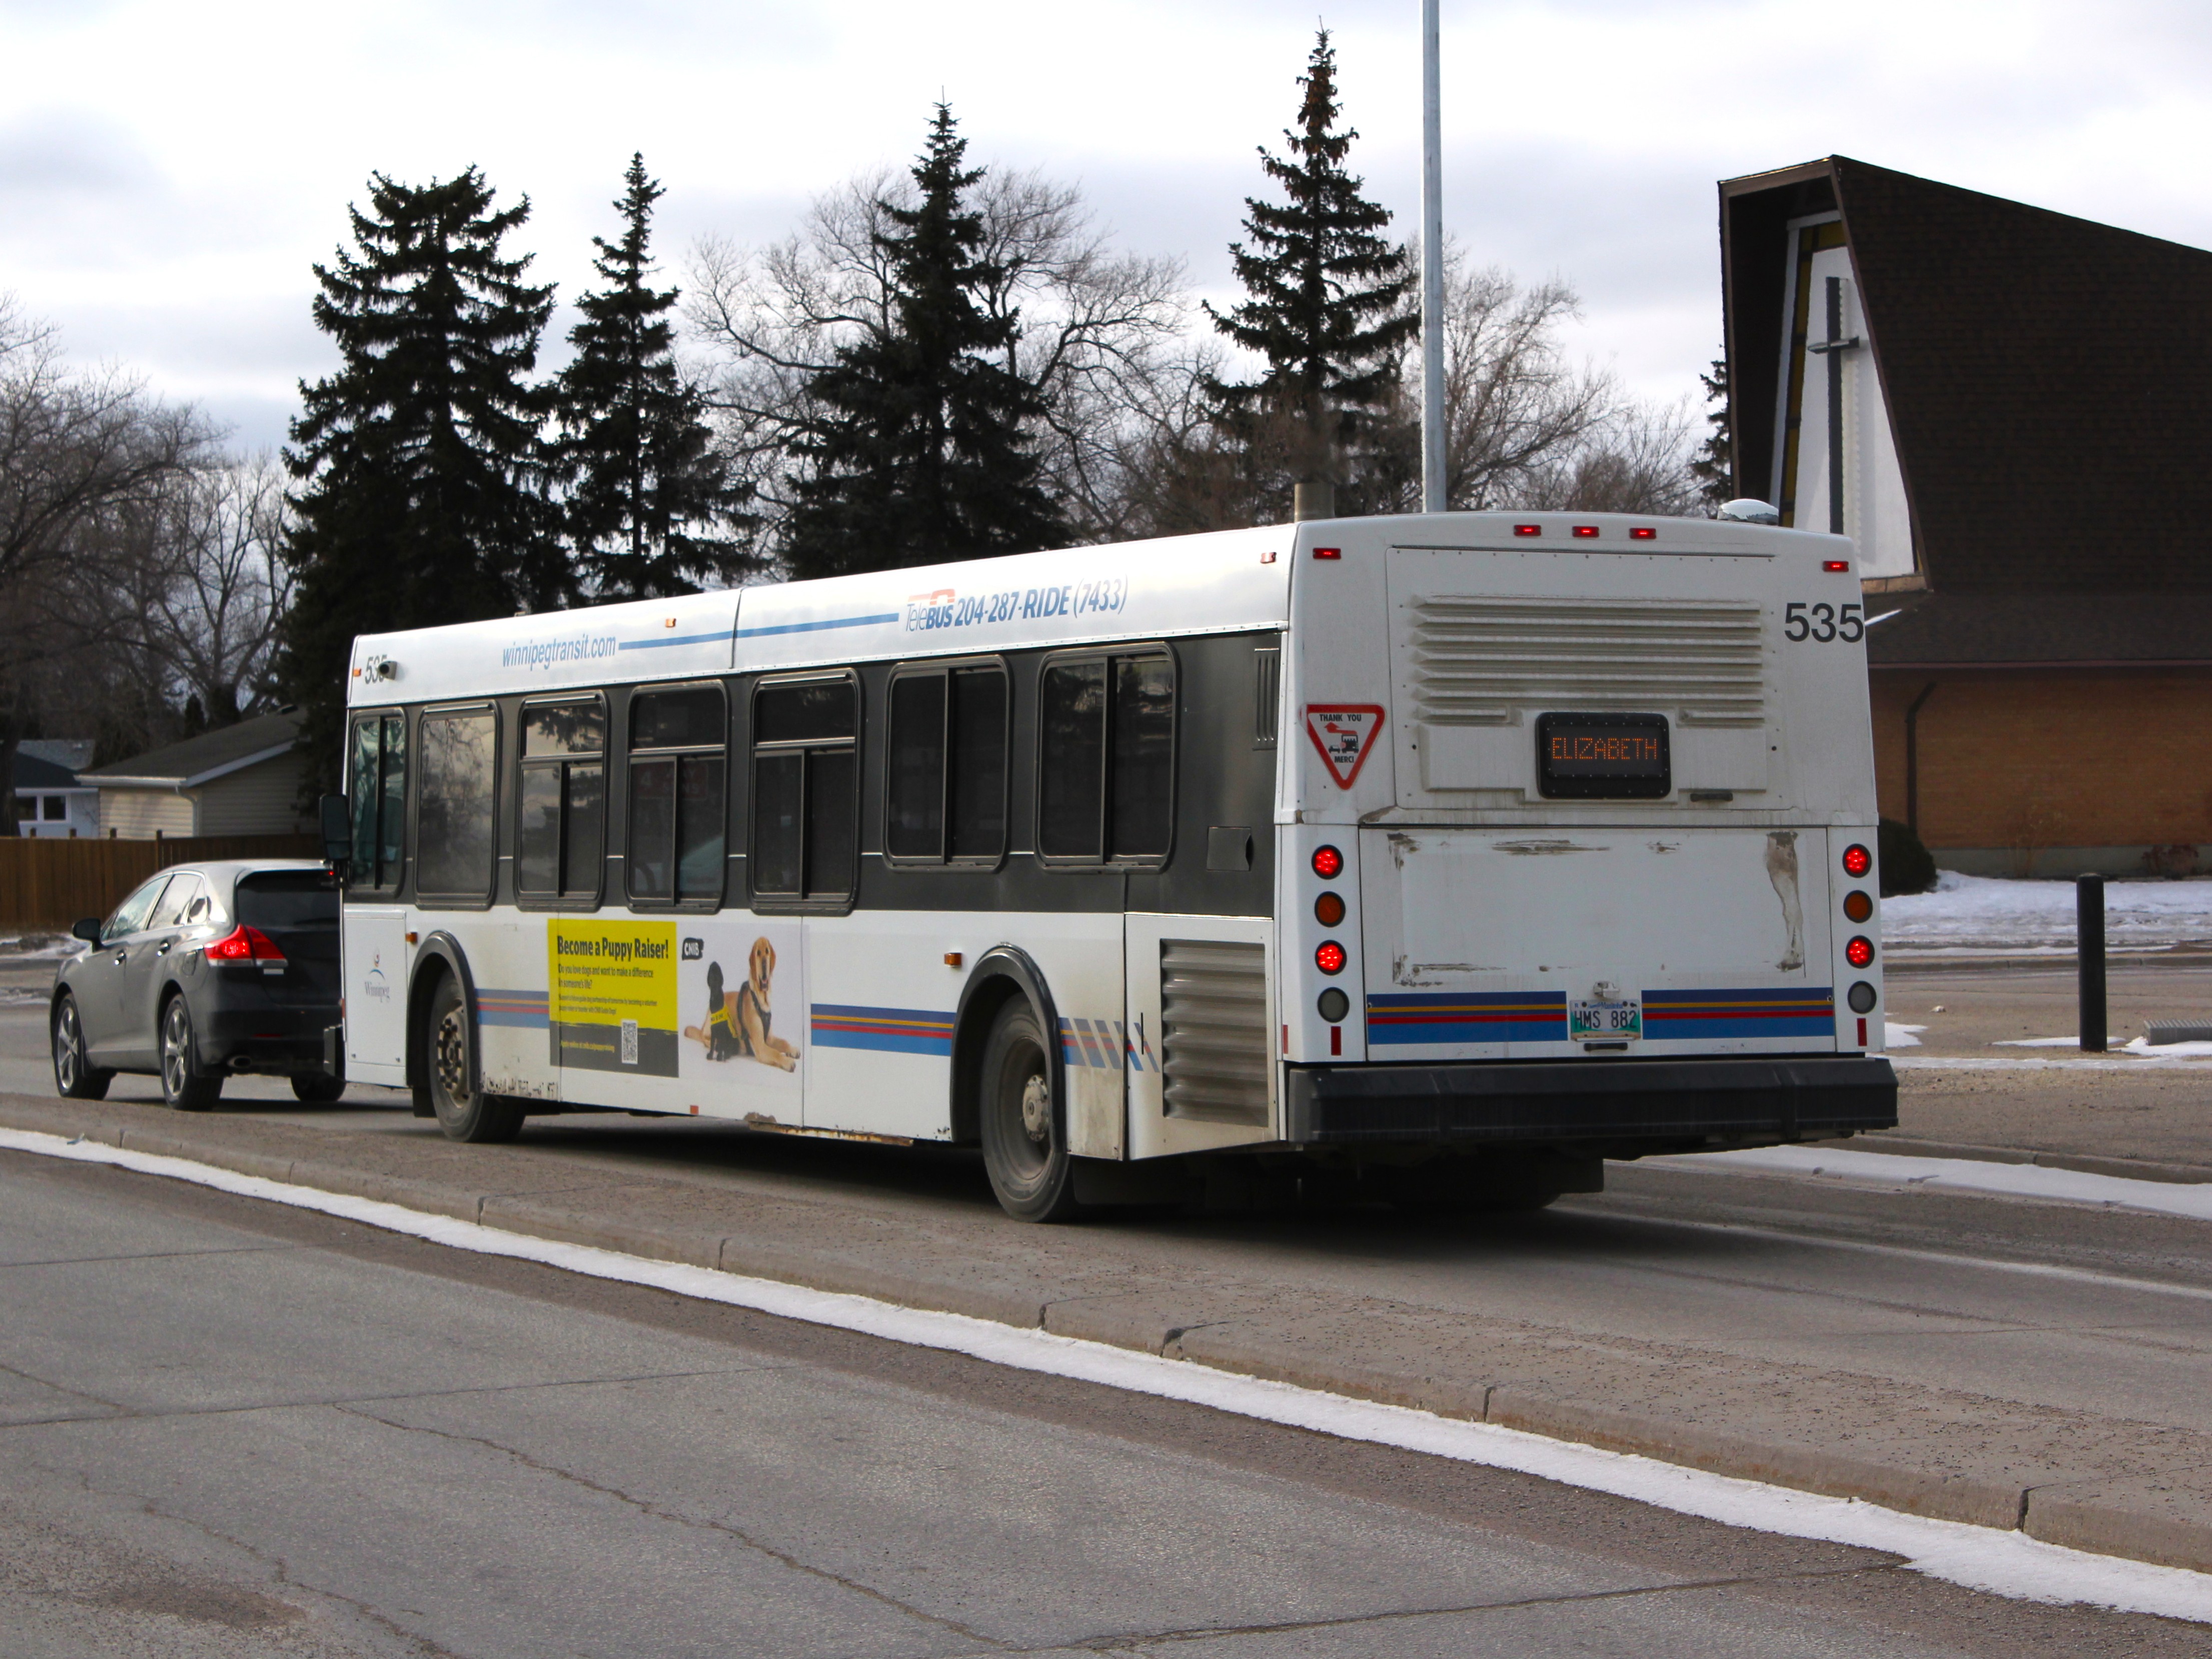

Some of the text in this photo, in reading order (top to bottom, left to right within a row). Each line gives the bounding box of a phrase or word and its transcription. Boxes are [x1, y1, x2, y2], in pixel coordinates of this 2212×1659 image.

[955, 585, 1072, 627] 204-287-RIDE
[1073, 574, 1128, 618] (7433)
[1784, 603, 1864, 643] 535
[503, 634, 616, 671] winnipegtransit.com
[1319, 714, 1343, 722] THANK
[1552, 737, 1657, 760] ELIZABETH
[558, 936, 669, 962] Become a Puppy Raiser!
[684, 942, 699, 956] CNIB
[558, 964, 564, 973] Do
[572, 965, 581, 974] love
[581, 965, 591, 976] dogs
[592, 966, 600, 975] and
[600, 967, 610, 976] want
[611, 967, 616, 976] to
[616, 967, 628, 976] make
[632, 967, 653, 978] difference
[365, 981, 390, 1003] Winnipeg
[564, 979, 583, 988] someone's
[1574, 1010, 1637, 1029] HMS 882
